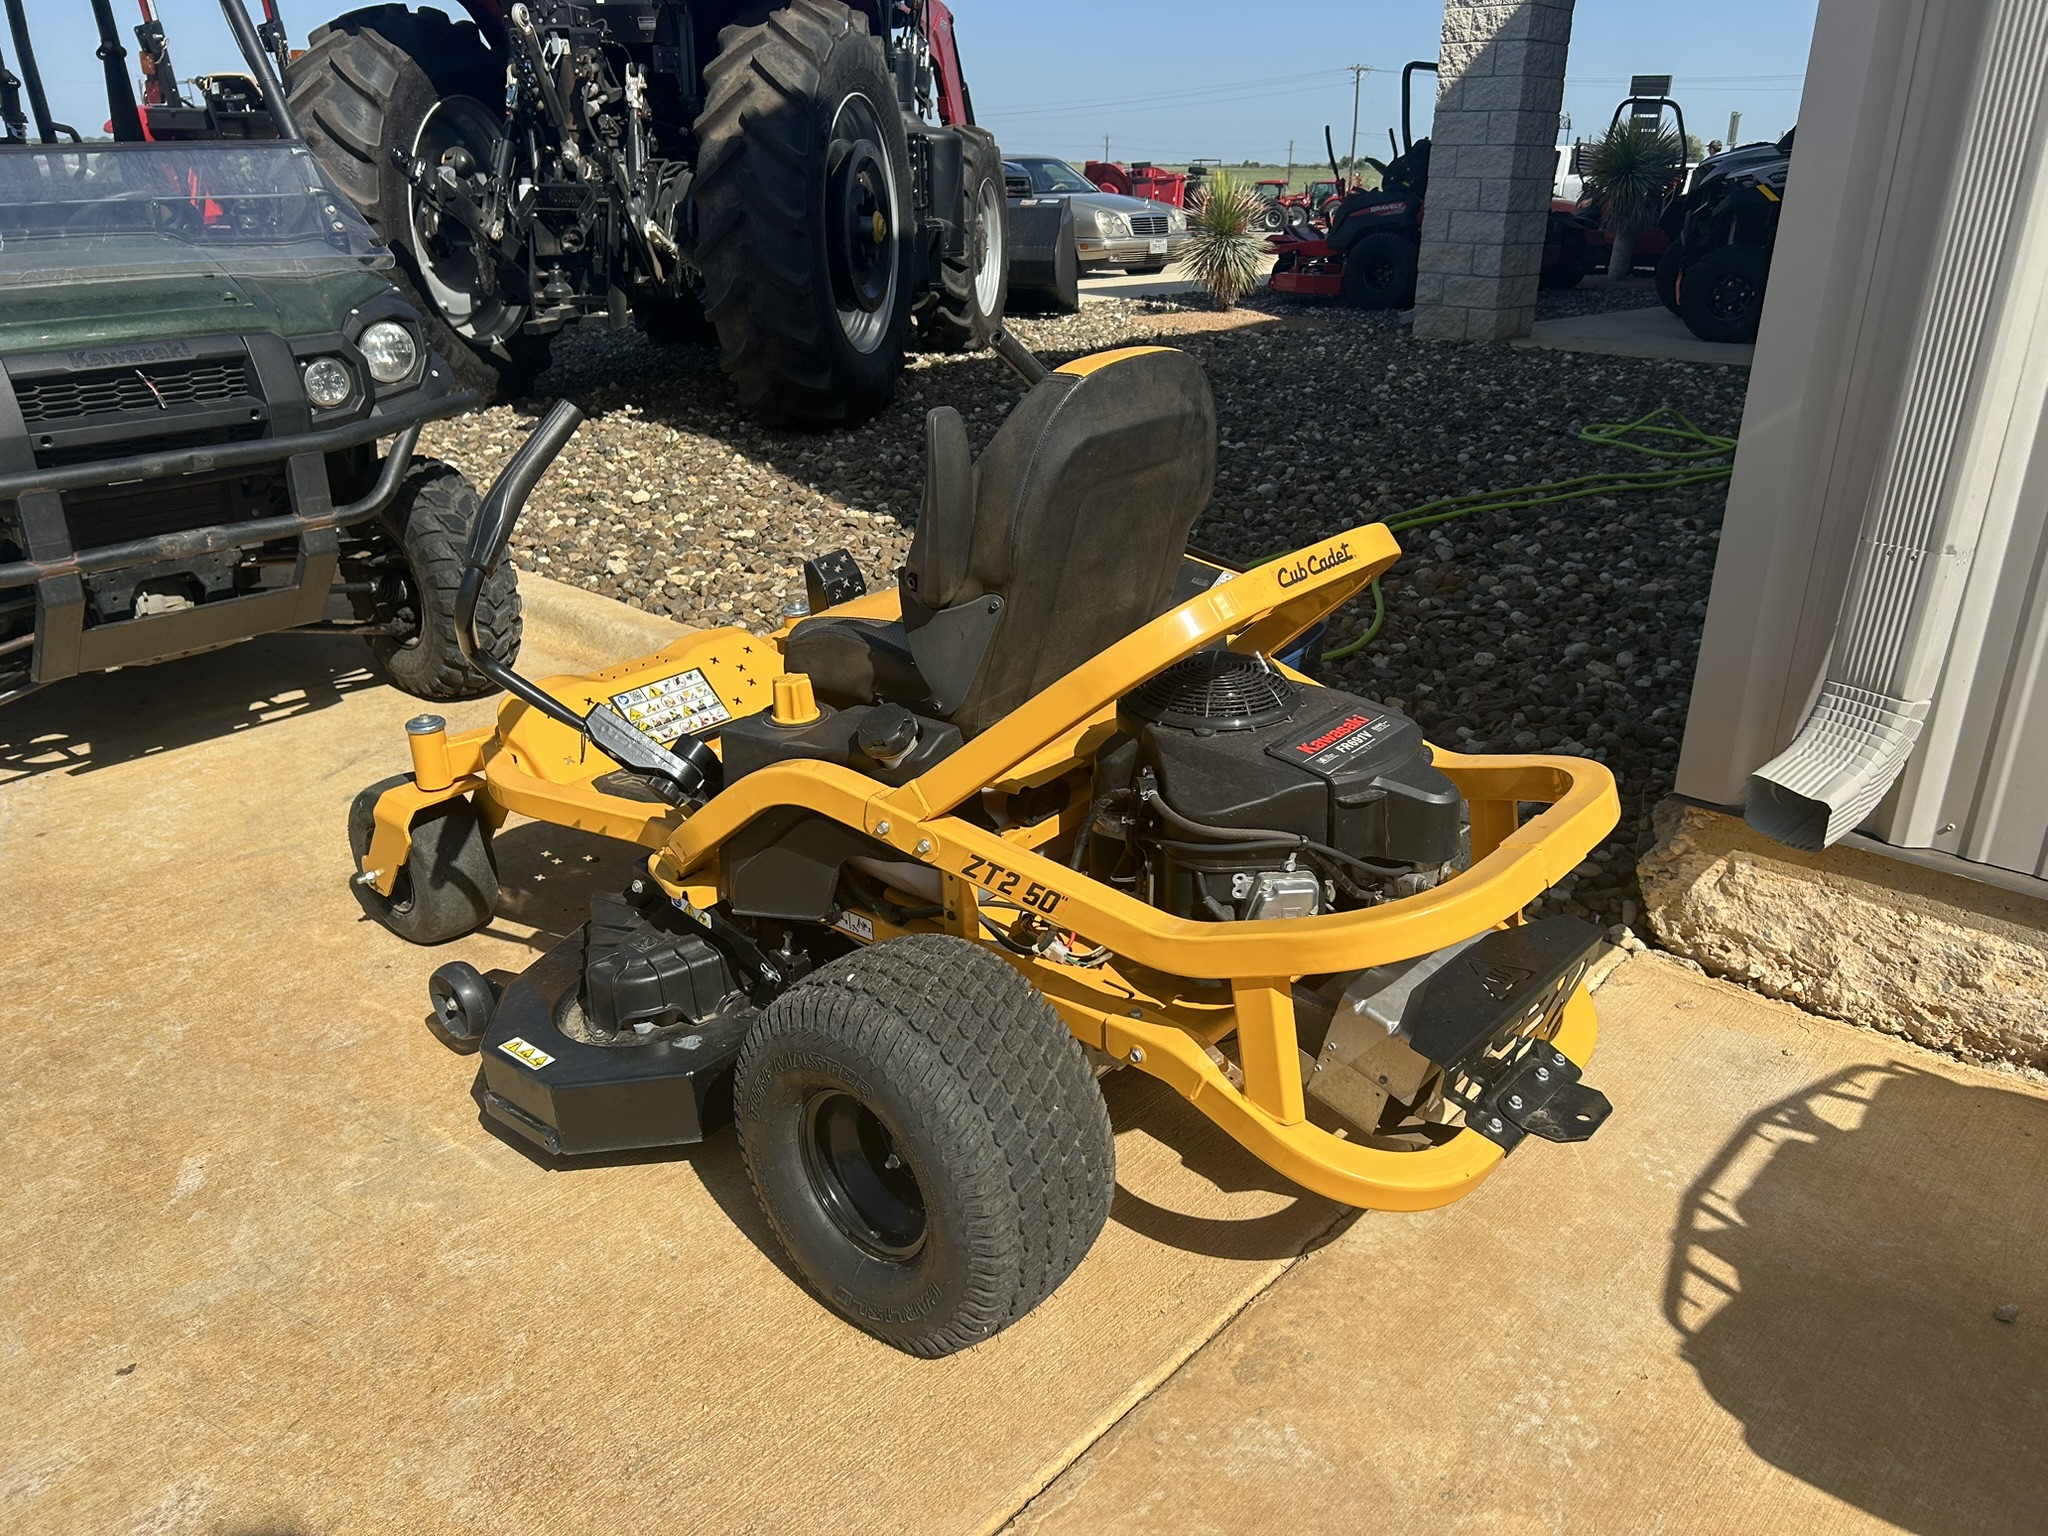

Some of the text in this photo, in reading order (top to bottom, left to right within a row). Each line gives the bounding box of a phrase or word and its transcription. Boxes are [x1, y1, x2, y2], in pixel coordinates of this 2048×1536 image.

[1370, 202, 1403, 212] GRAVELY
[67, 341, 192, 368] Kawasaki
[1278, 542, 1353, 588] Cub Cadet
[1296, 714, 1370, 755] Kawasaki
[1335, 730, 1373, 753] FR691V
[961, 853, 1021, 896] ZT2
[773, 1050, 874, 1100] MASTER
[834, 1280, 942, 1323] CARLISLE
